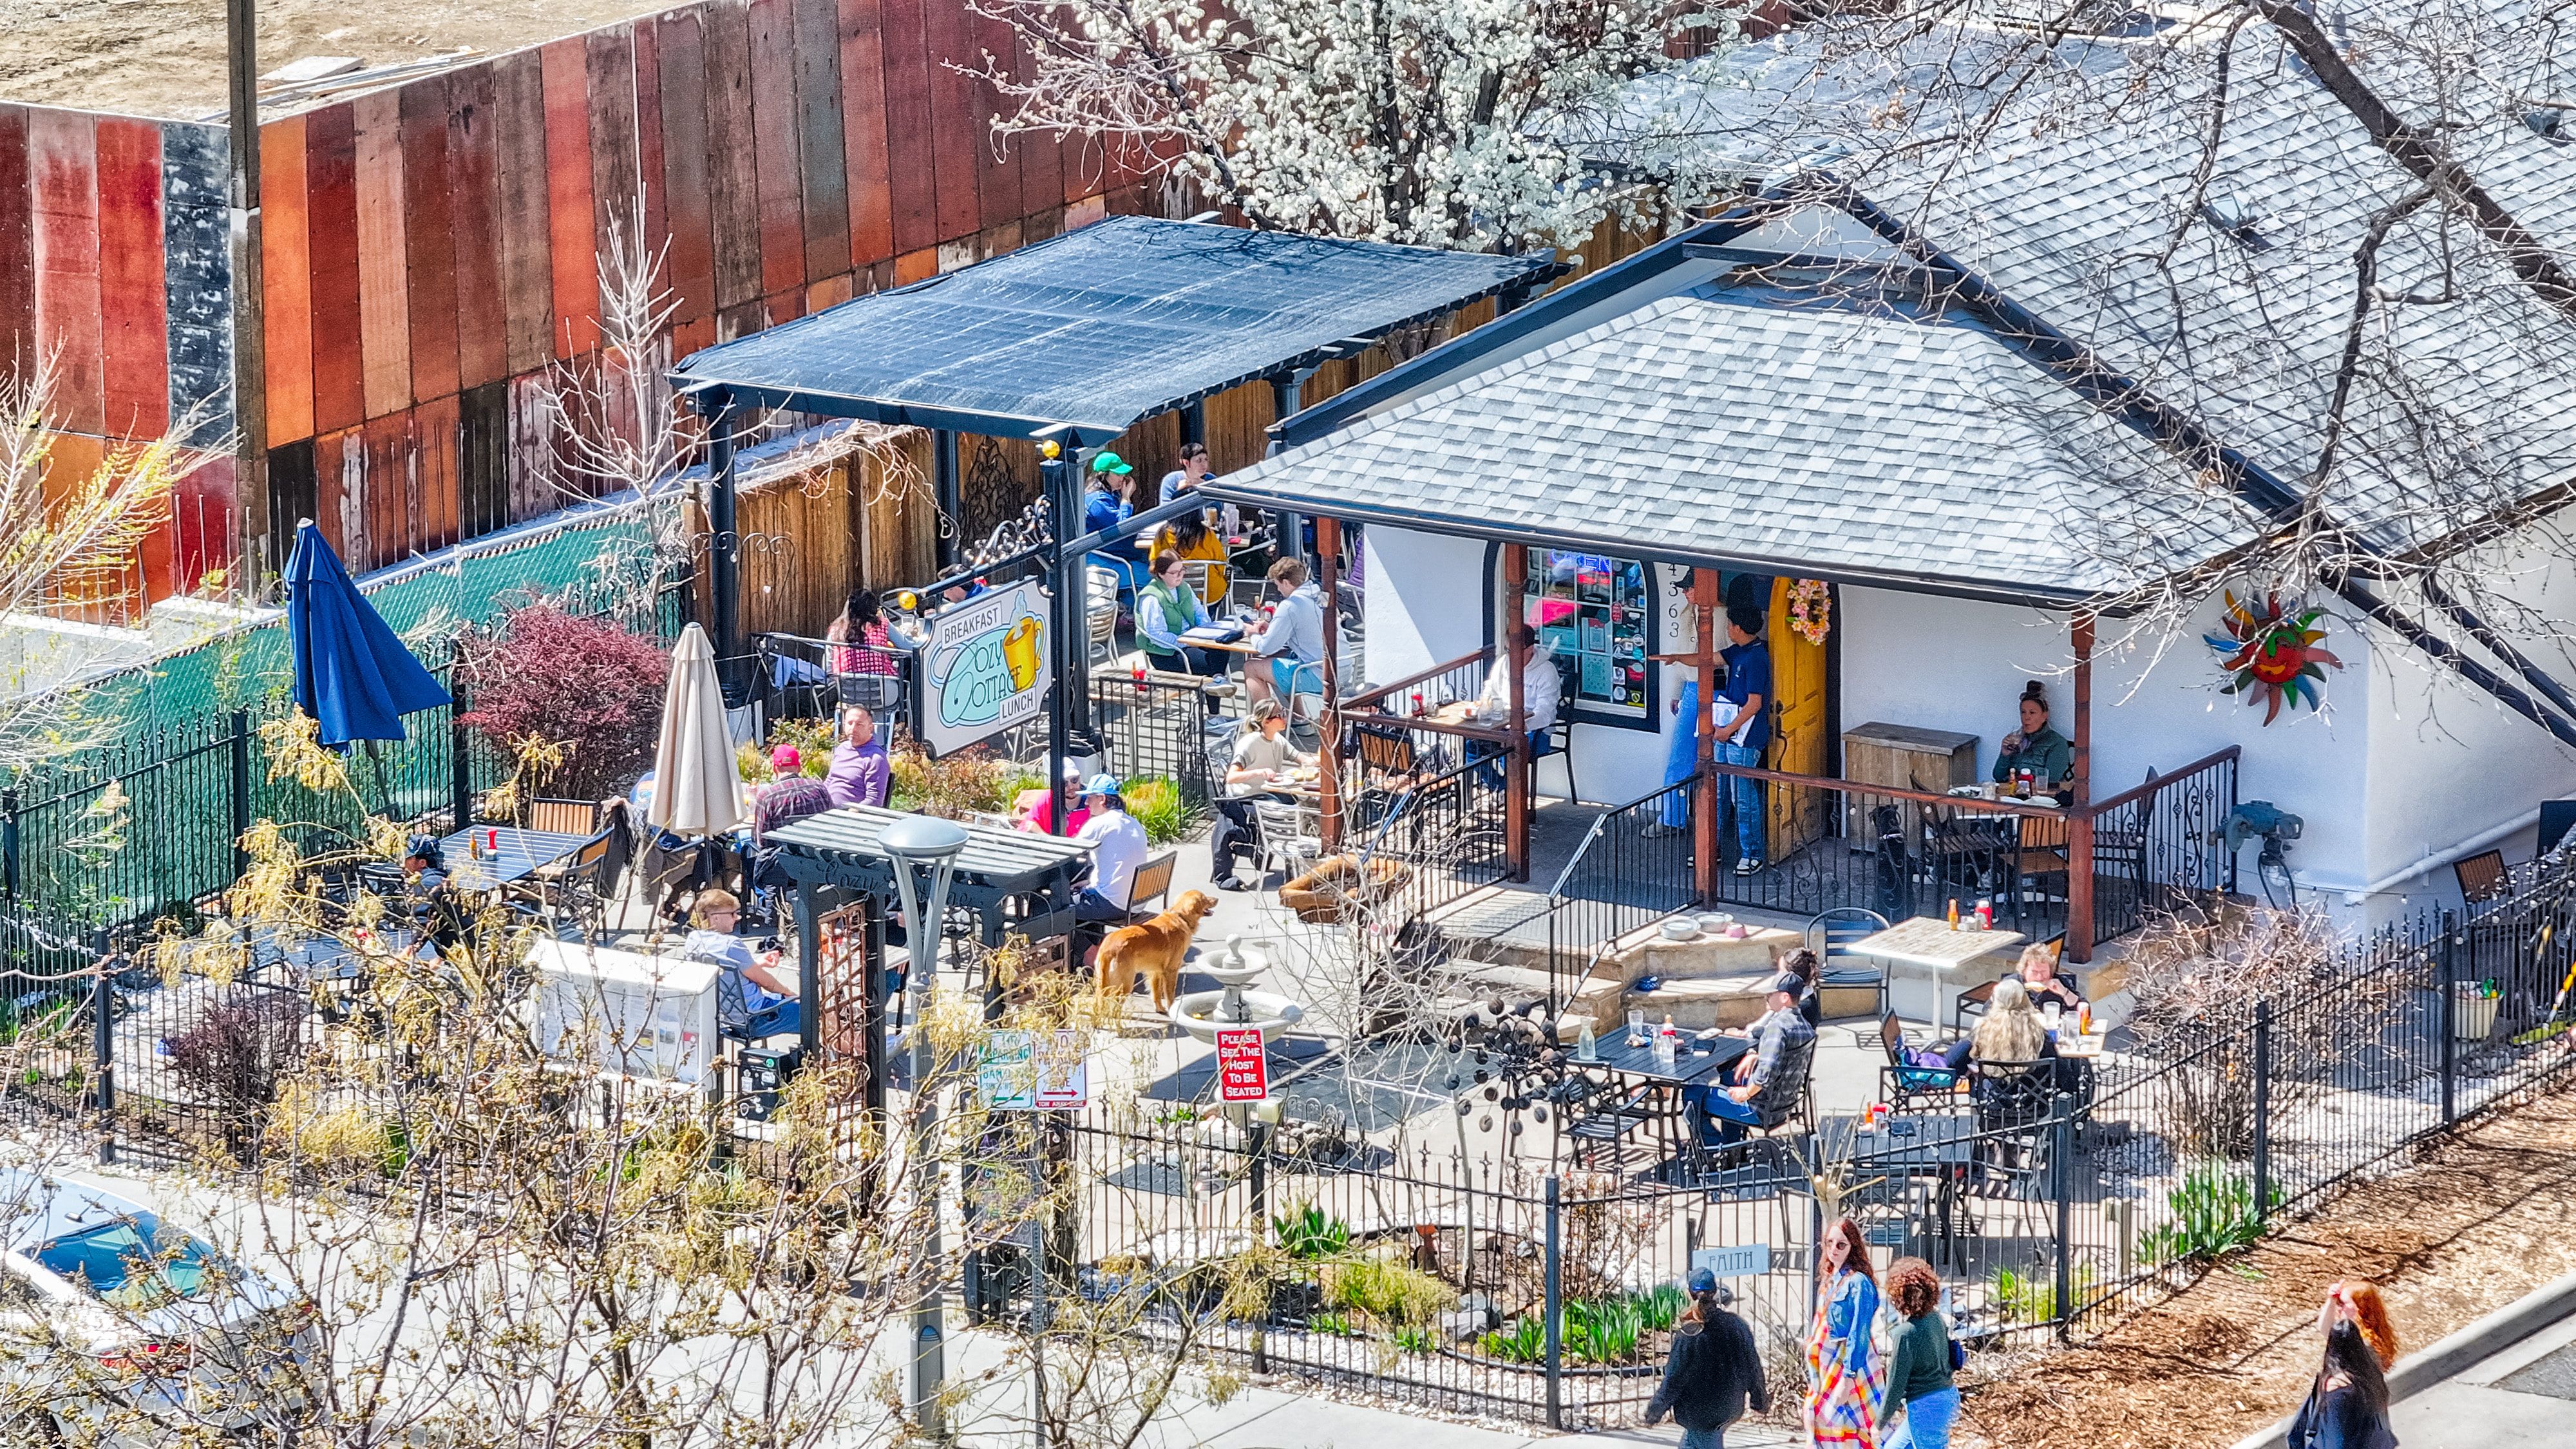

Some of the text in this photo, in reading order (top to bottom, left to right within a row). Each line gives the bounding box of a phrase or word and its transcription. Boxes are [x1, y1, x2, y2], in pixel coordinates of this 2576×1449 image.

[944, 607, 999, 645] BREAKFAST
[941, 665, 1022, 723] COTTAGE
[1001, 692, 1034, 719] LUNCH
[1220, 1034, 1258, 1045] PLEASE
[1240, 1046, 1261, 1057] THE
[1229, 1060, 1255, 1070] HOST
[1228, 1073, 1258, 1083] TO BE
[1226, 1086, 1263, 1097] SEATED
[1709, 1251, 1754, 1272] FAITH
